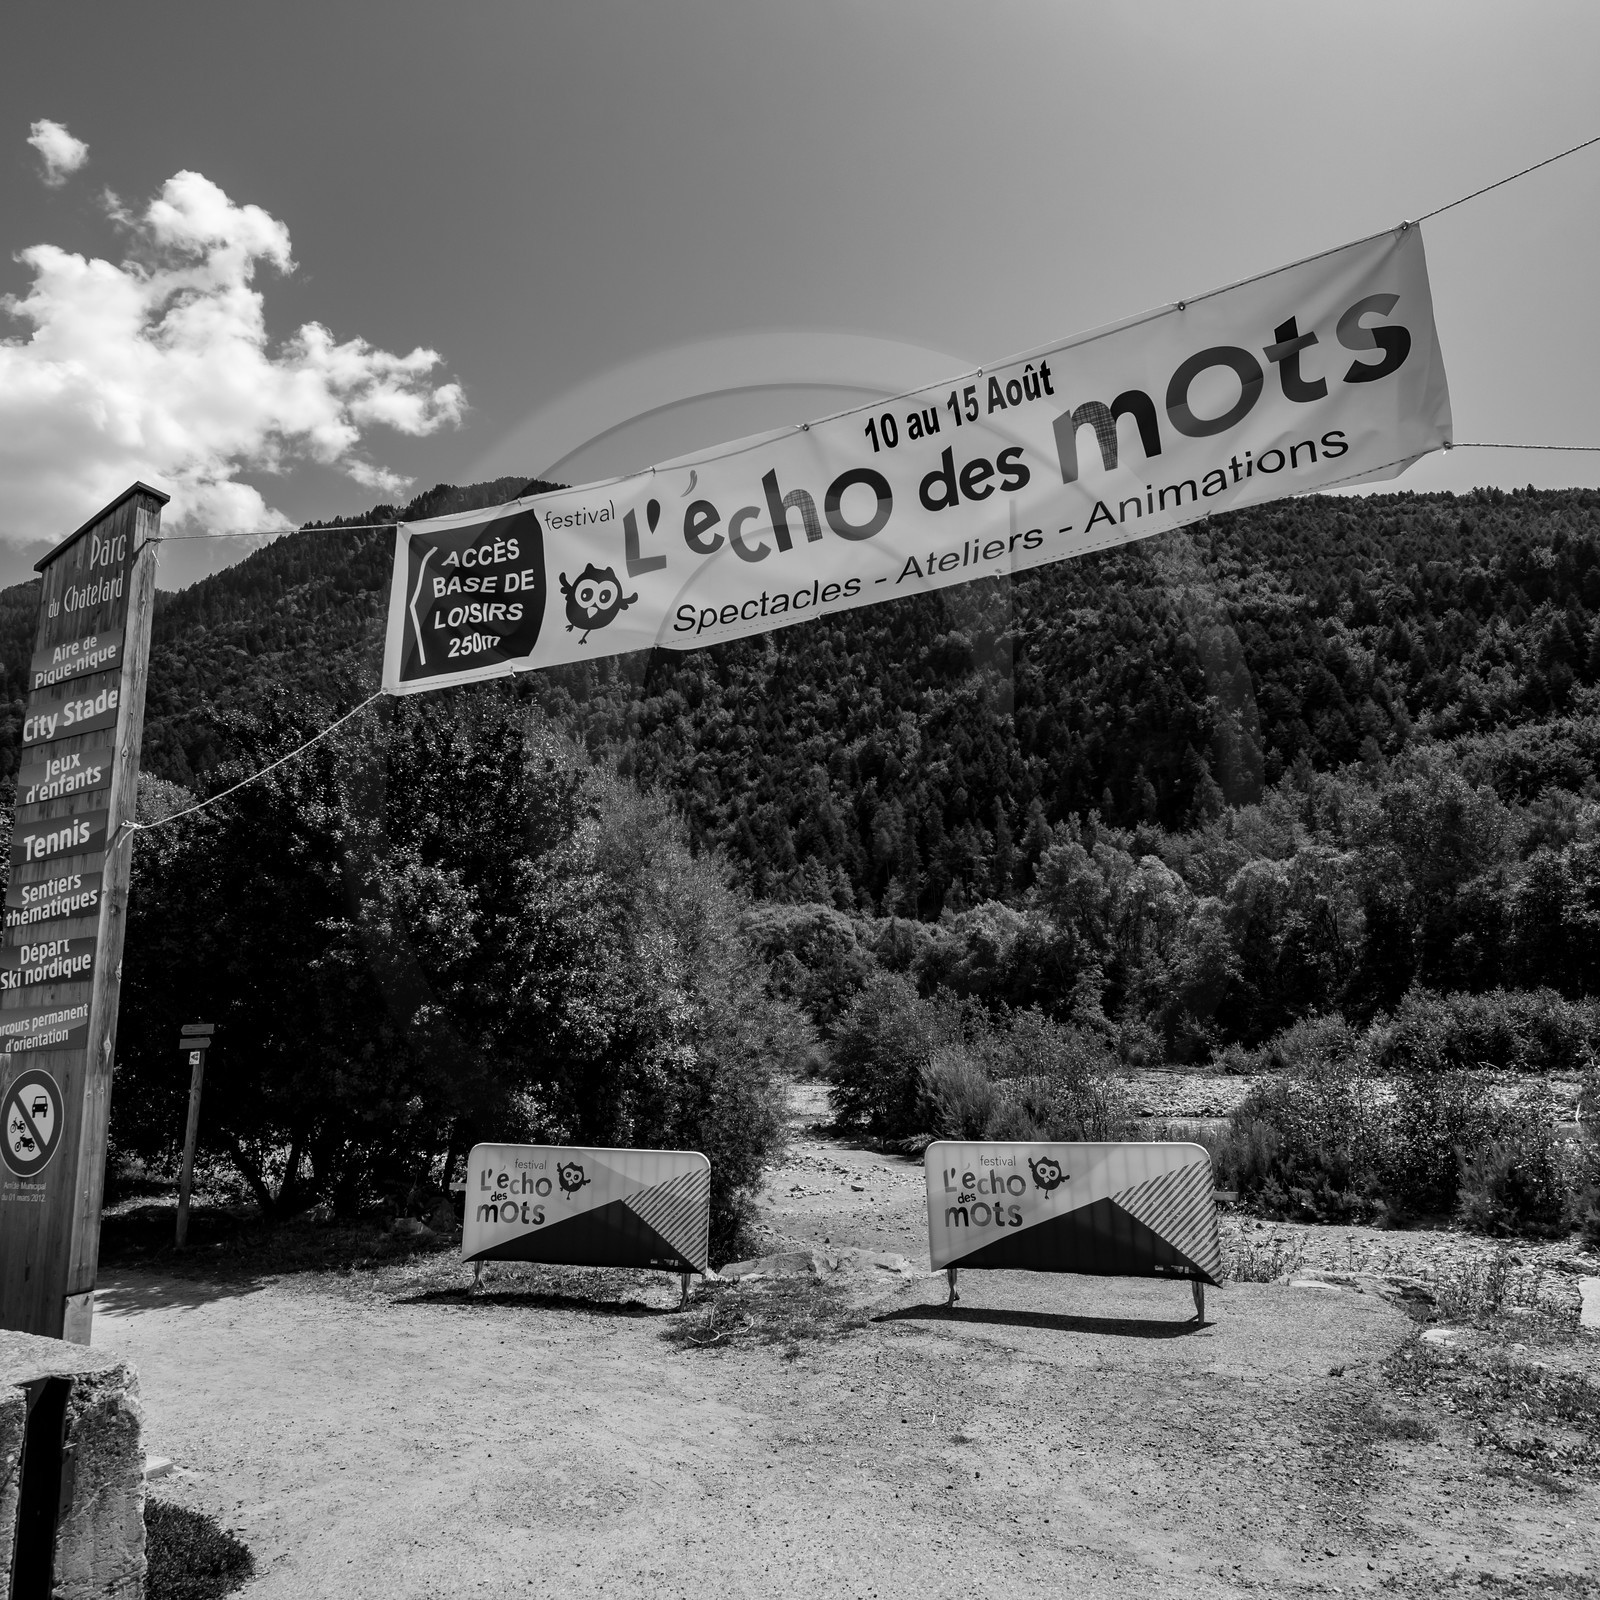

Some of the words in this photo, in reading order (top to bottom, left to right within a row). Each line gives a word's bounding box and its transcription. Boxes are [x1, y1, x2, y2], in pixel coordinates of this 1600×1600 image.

[864, 413, 898, 453] 10
[906, 406, 941, 440] au
[947, 385, 979, 427] 15
[988, 359, 1054, 415] Août
[918, 445, 1031, 512] des
[544, 499, 615, 531] festival
[673, 577, 861, 634] Spectacles
[895, 527, 1044, 584] Ateliers
[1084, 430, 1349, 534] Animations
[89, 533, 127, 570] Parc
[441, 536, 520, 568] ACCÈS
[48, 598, 60, 619] du
[63, 569, 124, 613] Chatelard
[432, 574, 498, 598] BASE
[504, 568, 535, 592] DE
[434, 602, 524, 630] LOISIRS
[52, 643, 80, 665] Aire
[83, 635, 98, 650] de
[447, 631, 501, 658] 250m
[34, 644, 117, 690] Pique-nique
[22, 711, 58, 742] City
[63, 689, 119, 726] Stade
[44, 753, 81, 783] Jeux
[25, 766, 102, 804] d'enfants
[23, 819, 91, 861] Tennis
[21, 874, 82, 905] Sentiers
[5, 889, 98, 928] thématiques
[20, 938, 70, 965] Départ
[0, 967, 22, 990] Ski
[24, 953, 92, 985] nordique
[0, 1018, 30, 1037] rcours
[32, 1003, 89, 1032] permanent
[5, 1028, 69, 1053] d'orientation
[514, 1158, 547, 1170] festival
[980, 1154, 1016, 1167] festival
[30, 1193, 46, 1203] 2012
[490, 1190, 508, 1202] des
[957, 1191, 977, 1205] des
